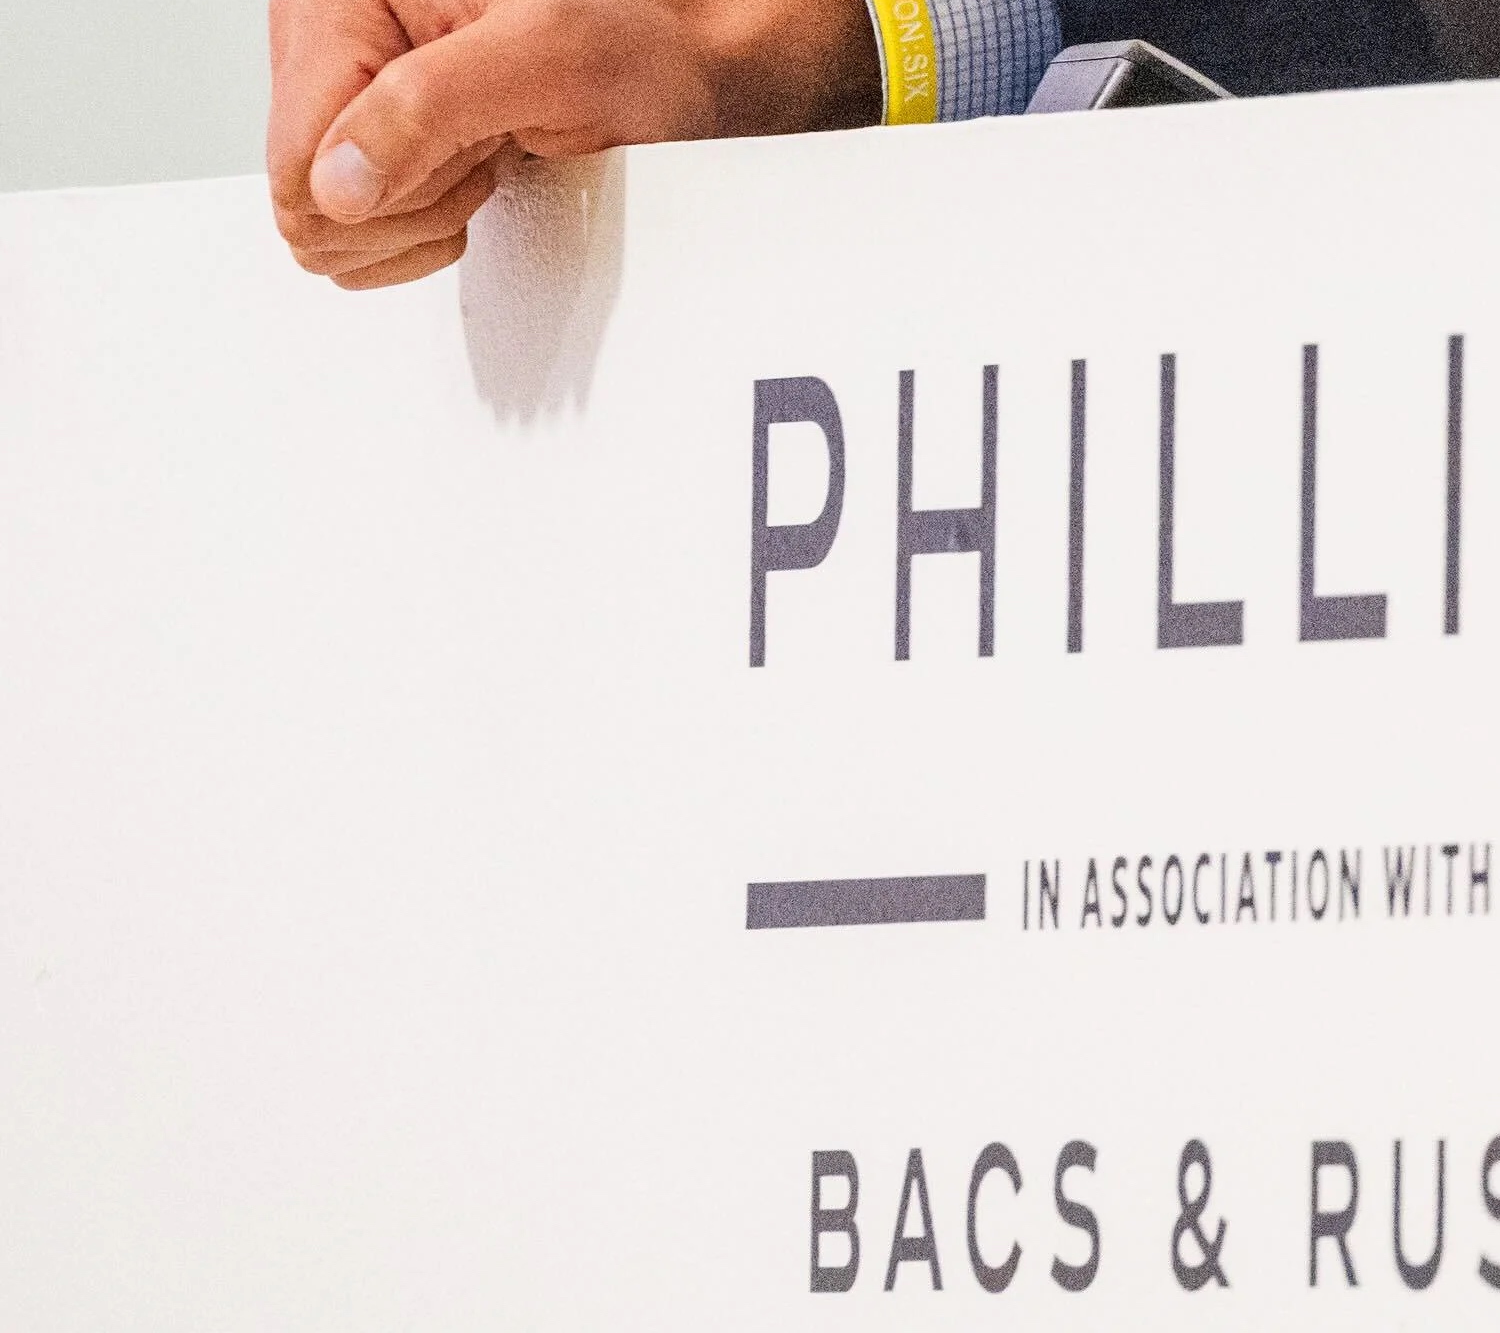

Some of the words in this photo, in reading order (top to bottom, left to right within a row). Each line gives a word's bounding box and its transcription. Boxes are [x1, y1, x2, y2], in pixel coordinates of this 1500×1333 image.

[1022, 859, 1061, 930] IN
[1080, 847, 1363, 930] ASSOCIATION
[1383, 841, 1492, 916] WITH
[809, 1139, 1102, 1295] BACS
[1170, 1138, 1230, 1293] &
